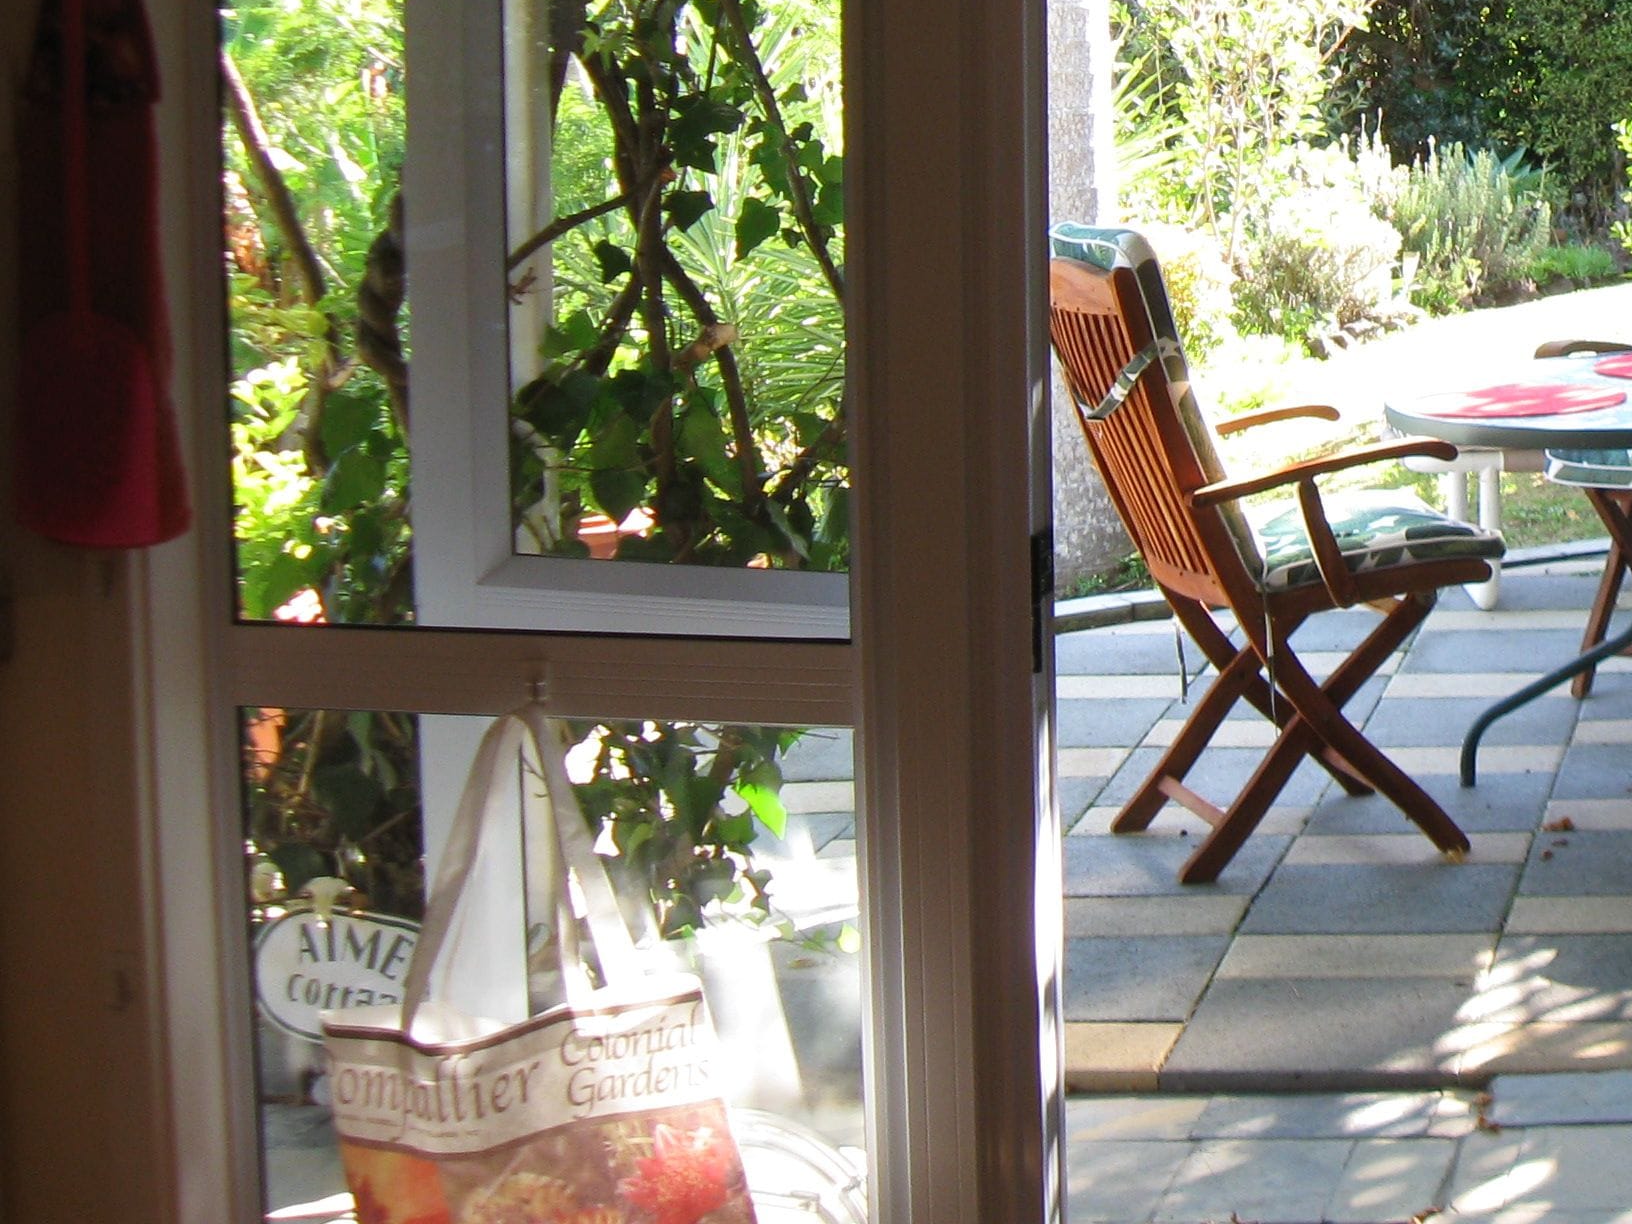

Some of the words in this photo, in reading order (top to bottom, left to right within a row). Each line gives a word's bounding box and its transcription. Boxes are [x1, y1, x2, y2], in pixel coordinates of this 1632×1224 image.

[562, 1001, 700, 1066] Colonial
[328, 1054, 541, 1135] ompallier
[568, 1057, 709, 1112] Gardens
